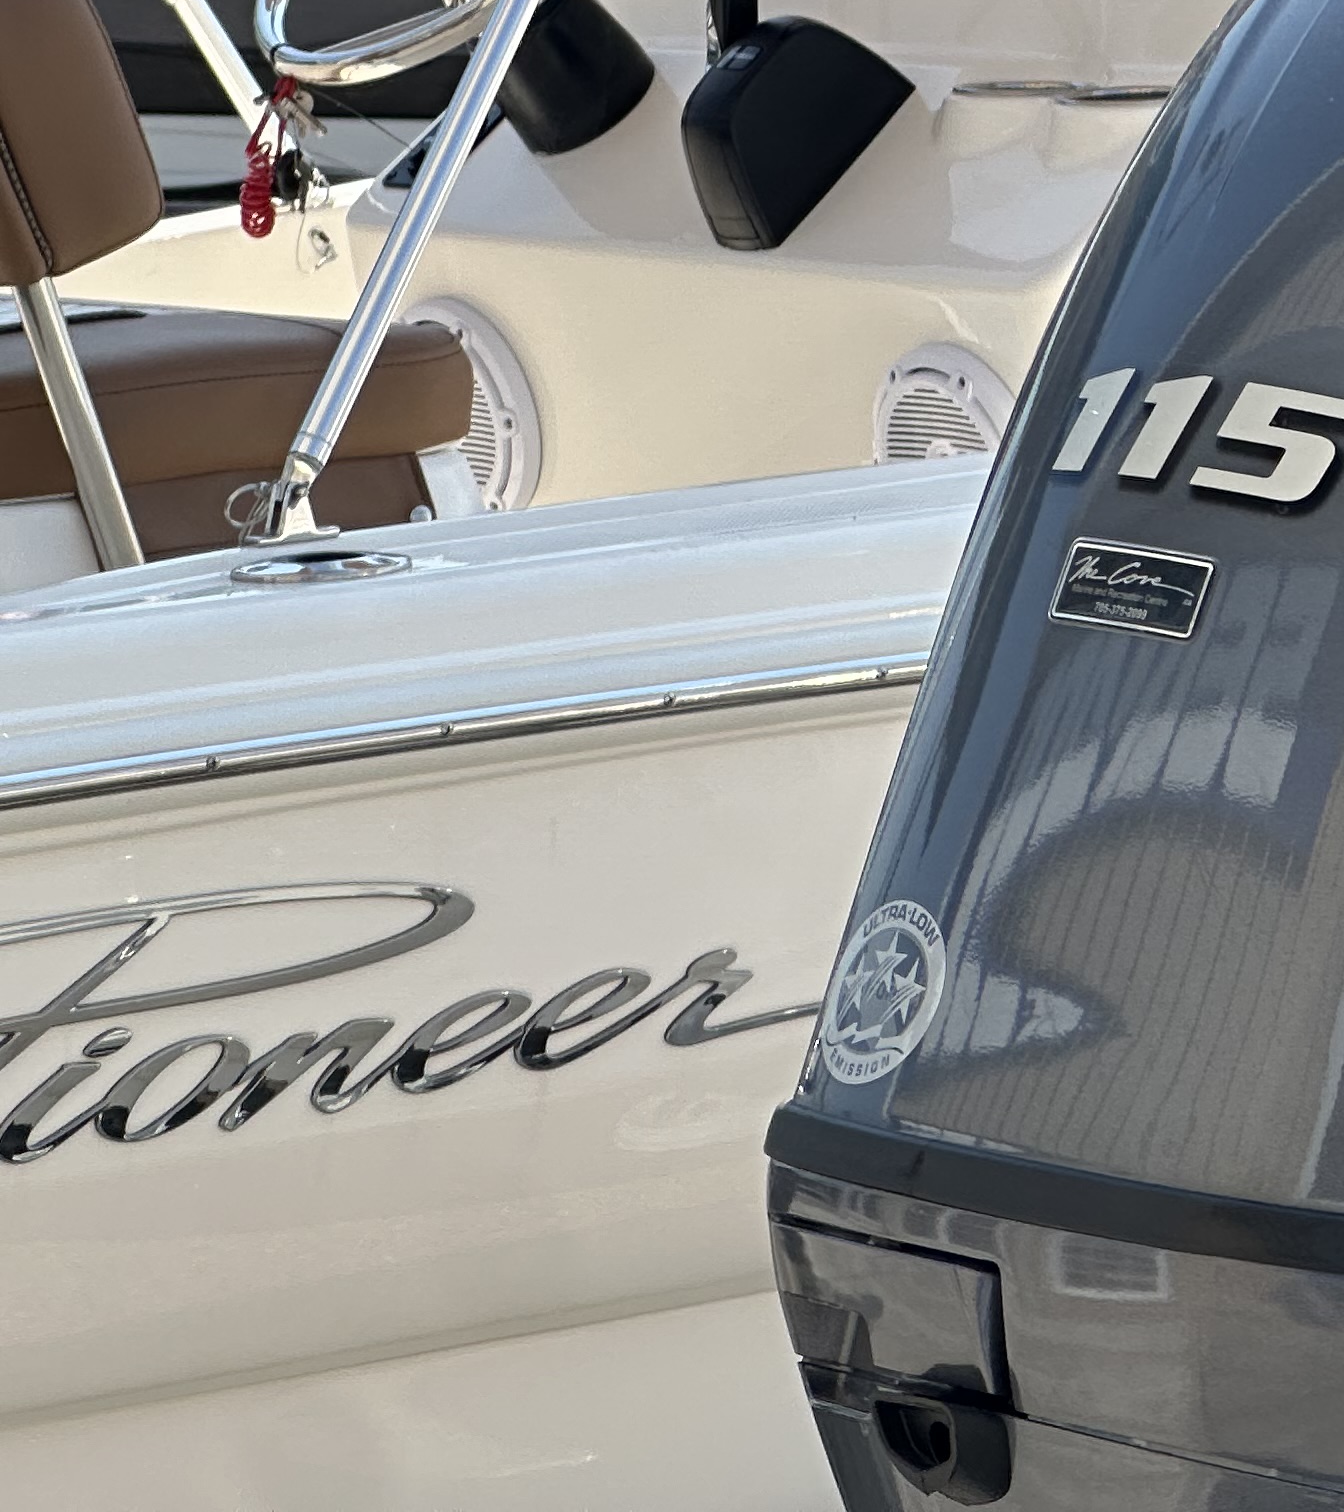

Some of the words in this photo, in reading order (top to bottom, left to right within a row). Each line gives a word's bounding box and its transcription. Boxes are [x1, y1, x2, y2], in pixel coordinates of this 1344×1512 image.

[1068, 555, 1106, 583] The
[1108, 561, 1195, 597] Cove
[829, 1046, 891, 1078] EMISSION
